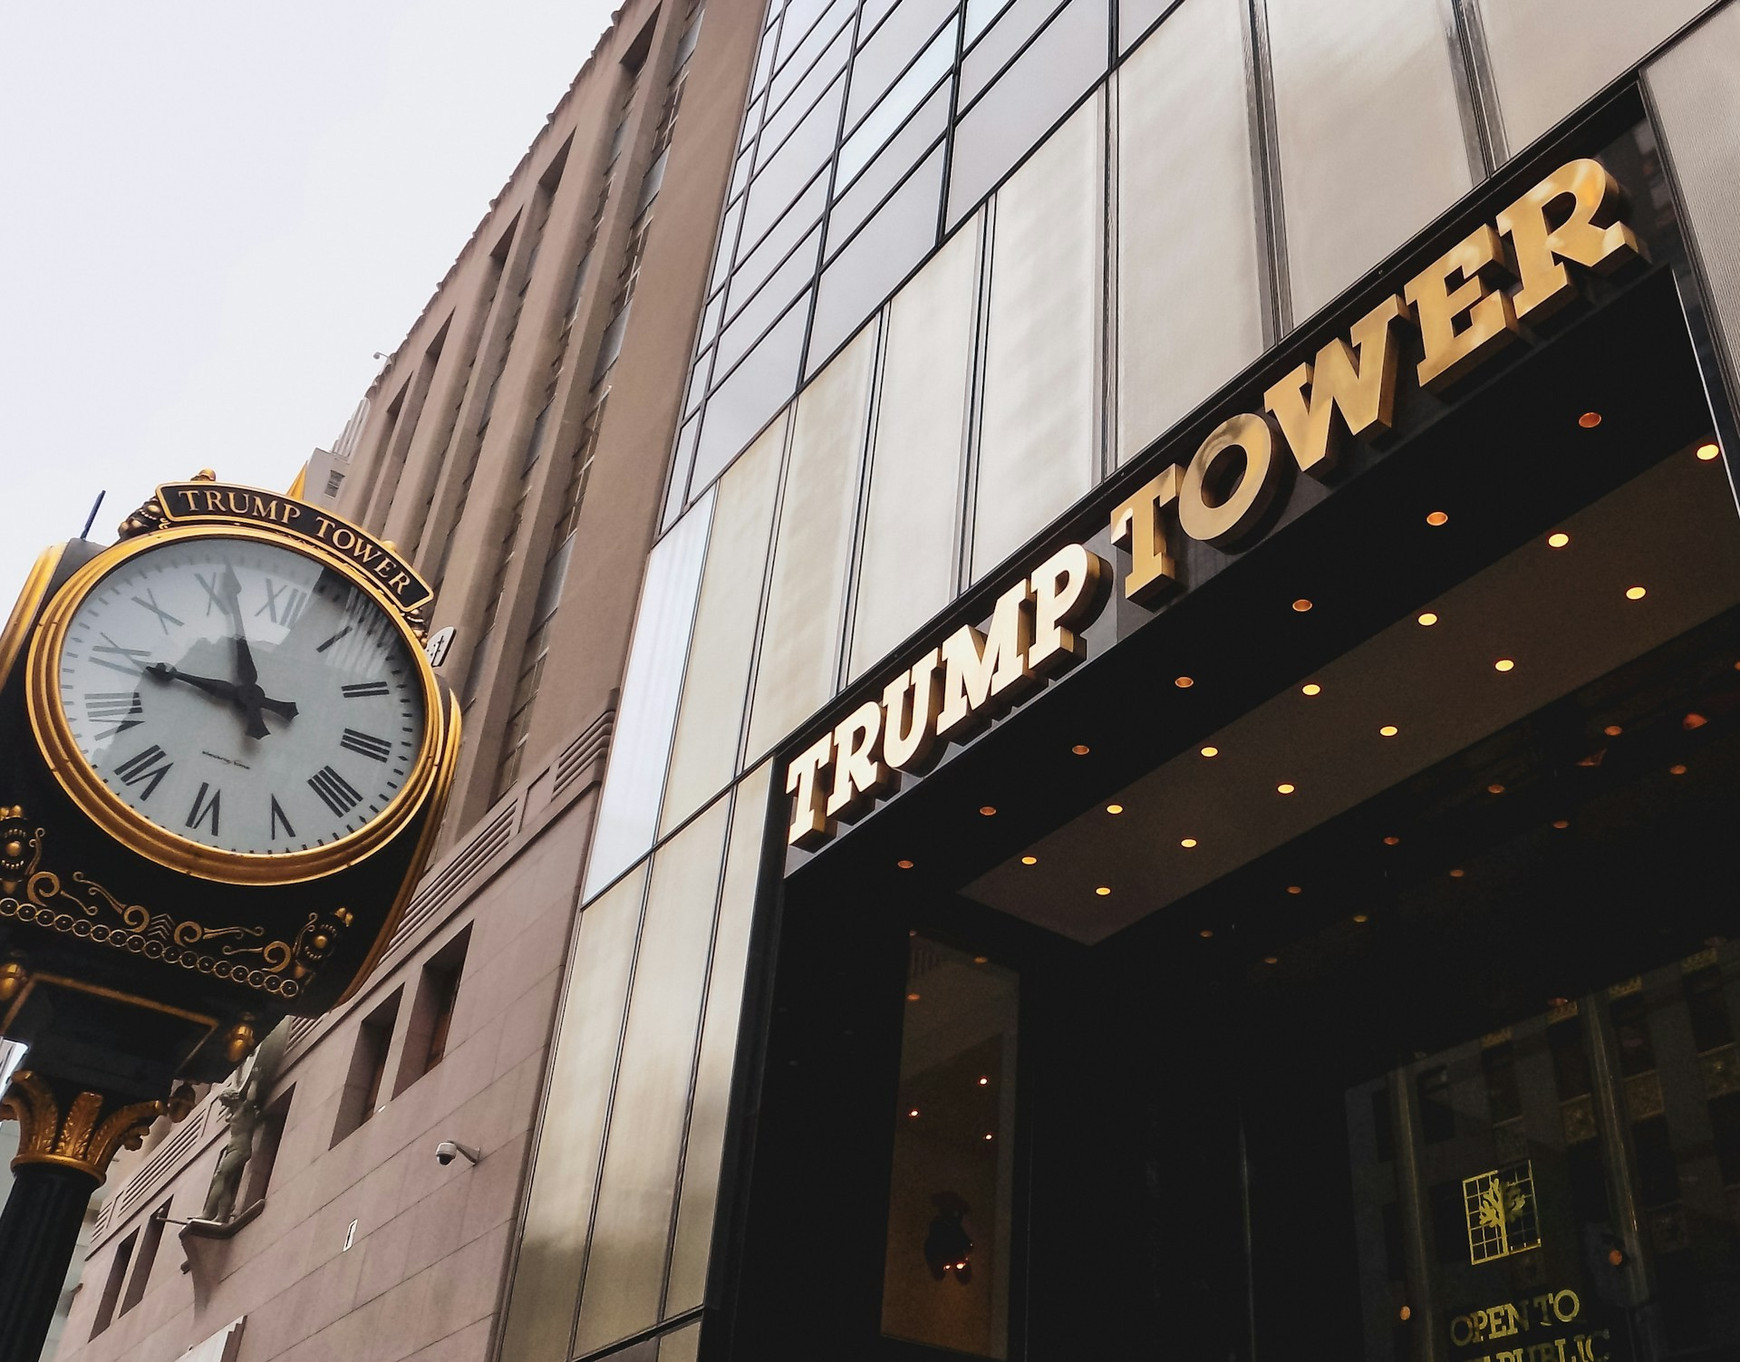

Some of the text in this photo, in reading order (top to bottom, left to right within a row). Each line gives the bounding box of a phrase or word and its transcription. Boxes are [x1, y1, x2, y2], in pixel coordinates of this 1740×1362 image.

[785, 157, 1636, 850] TRUMP TOWER
[178, 489, 411, 596] TRUMP TOWER
[131, 587, 185, 635] X
[341, 681, 390, 698] II
[114, 744, 174, 801] VII
[340, 728, 392, 763] III
[185, 782, 220, 836] VI
[271, 793, 296, 840] V
[1449, 1289, 1580, 1346] OPEN TO
